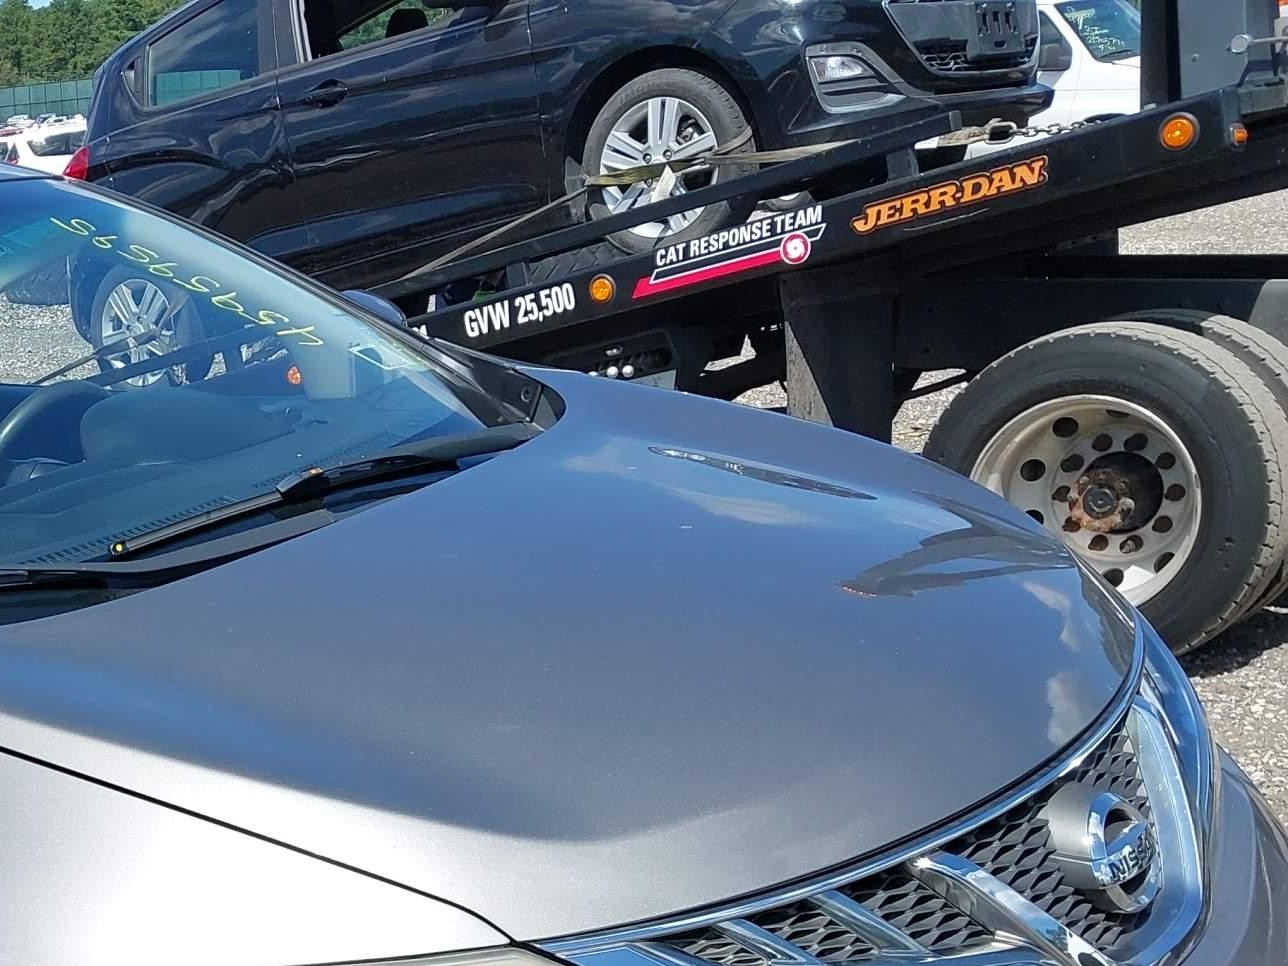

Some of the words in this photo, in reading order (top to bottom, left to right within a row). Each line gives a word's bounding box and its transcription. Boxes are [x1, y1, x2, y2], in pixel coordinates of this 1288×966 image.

[656, 243, 686, 266] CAT
[690, 220, 771, 258] RESPONSE
[775, 205, 823, 234] TEAM
[464, 300, 510, 338] GVW
[514, 282, 576, 325] 25,500
